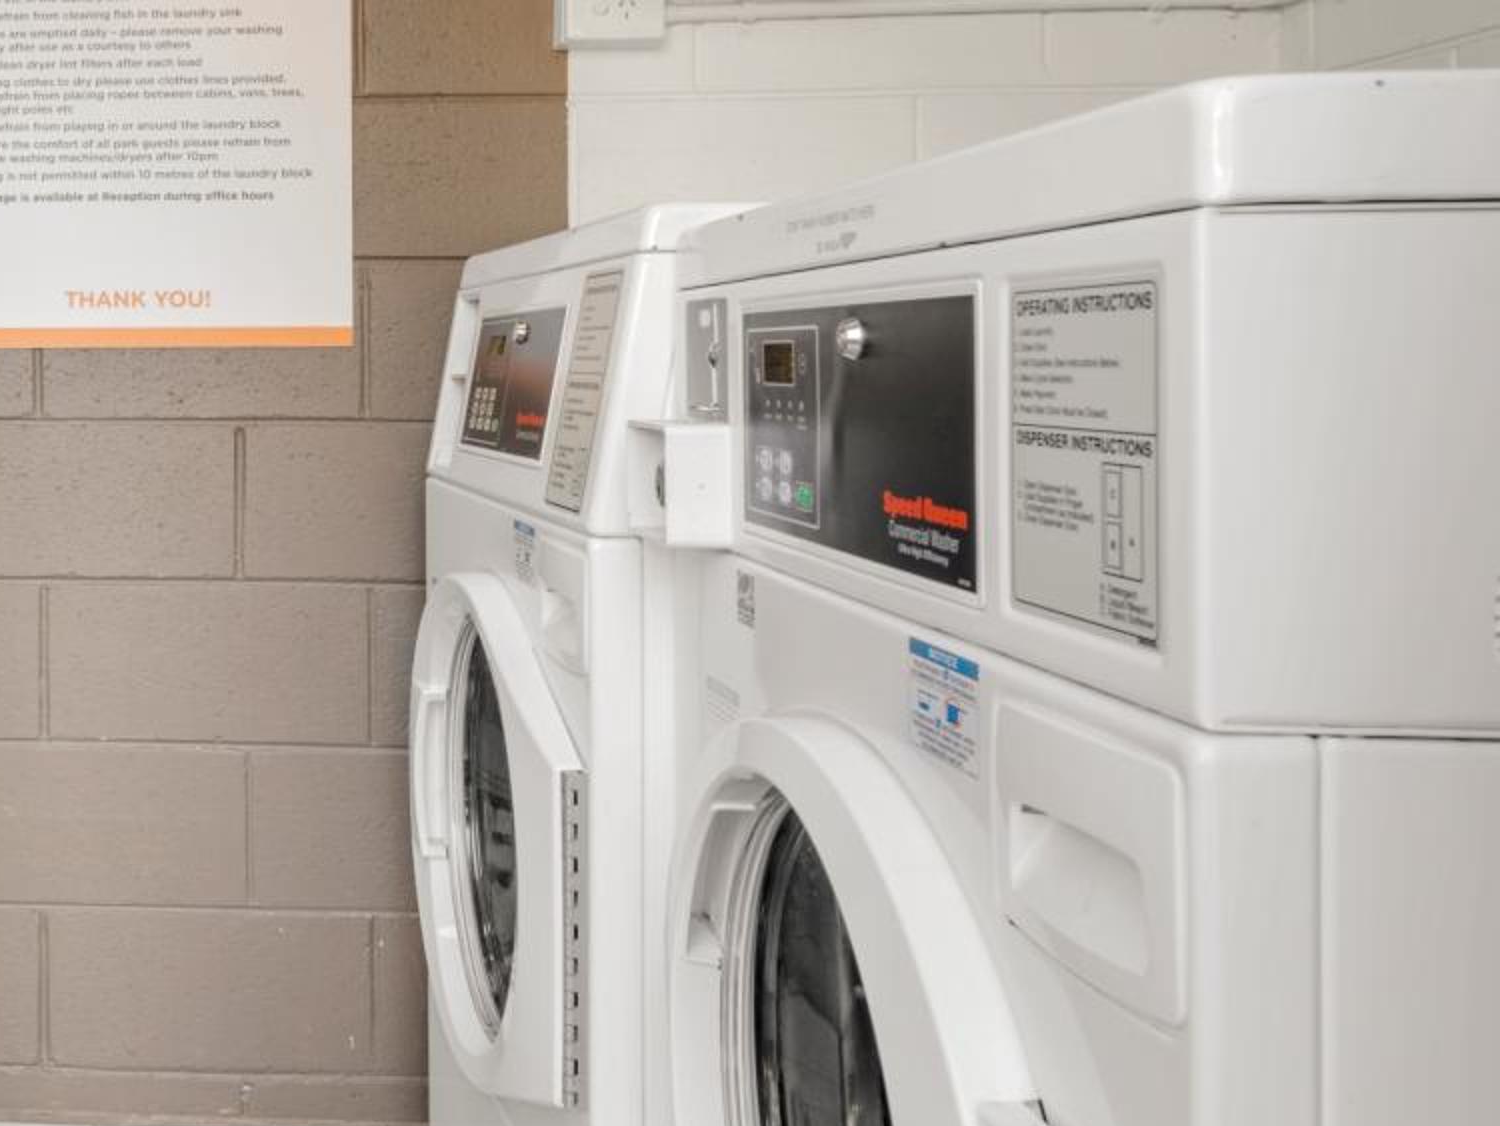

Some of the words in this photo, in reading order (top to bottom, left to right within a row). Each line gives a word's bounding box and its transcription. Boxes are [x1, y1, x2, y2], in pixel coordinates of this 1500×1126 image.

[34, 11, 58, 20] from
[63, 11, 110, 21] cleaning
[114, 10, 134, 19] fish
[138, 10, 148, 18] in
[151, 9, 169, 18] the
[173, 9, 216, 19] laundry
[220, 8, 242, 17] sink
[30, 30, 76, 39] emptied
[80, 29, 107, 39] daily
[120, 28, 156, 37] please
[207, 27, 232, 36] your
[235, 26, 283, 36] washing
[9, 43, 35, 51] after
[87, 42, 135, 52] courtesy
[140, 41, 151, 49] to
[155, 41, 191, 50] others
[26, 60, 55, 70] dryer
[60, 60, 76, 69] lint
[81, 59, 112, 68] filters
[116, 59, 142, 67] after
[147, 58, 173, 67] each
[177, 58, 202, 67] load
[14, 78, 54, 86] clothes
[58, 78, 69, 86] to
[73, 77, 91, 87] dry
[96, 77, 132, 87] please
[158, 76, 198, 84] clothes
[203, 75, 228, 84] lines
[34, 92, 60, 100] from
[64, 91, 104, 101] placing
[108, 91, 138, 100] ropes
[144, 89, 192, 98] between
[34, 122, 60, 131] from
[64, 122, 104, 132] playing
[108, 122, 118, 130] in
[122, 122, 133, 130] or
[137, 121, 177, 130] around
[181, 120, 199, 129] the
[203, 120, 245, 130] laundry
[250, 119, 281, 128] block
[12, 140, 30, 149] the
[33, 140, 78, 149] comfort
[82, 139, 93, 148] of
[97, 139, 109, 148] all
[113, 139, 138, 149] park
[142, 139, 179, 148] guests
[183, 138, 219, 148] please
[223, 138, 260, 147] refrain
[264, 137, 291, 145] from
[10, 154, 55, 164] washing
[156, 152, 182, 161] after
[187, 152, 219, 162] 10pm
[7, 172, 16, 180] is
[20, 172, 37, 180] not
[41, 171, 97, 181] permitted
[101, 170, 134, 179] within
[139, 170, 150, 178] 10
[155, 170, 194, 178] metres
[197, 169, 209, 178] of
[212, 169, 230, 178] the
[234, 169, 277, 179] laundry
[281, 168, 312, 177] block
[20, 193, 30, 202] is
[33, 192, 84, 202] available
[87, 193, 99, 201] at
[102, 191, 161, 202] Reception
[164, 191, 201, 202] during
[205, 190, 238, 200] office
[241, 190, 274, 200] hours
[65, 291, 146, 310] THANK
[156, 290, 211, 308] YOU!
[1017, 297, 1069, 316] OPERATING
[1072, 290, 1152, 314] INSTRUCTIONS
[1016, 430, 1068, 448] DISPENSER
[1072, 436, 1153, 458] INSTRUCTIONS
[884, 490, 922, 518] Speed
